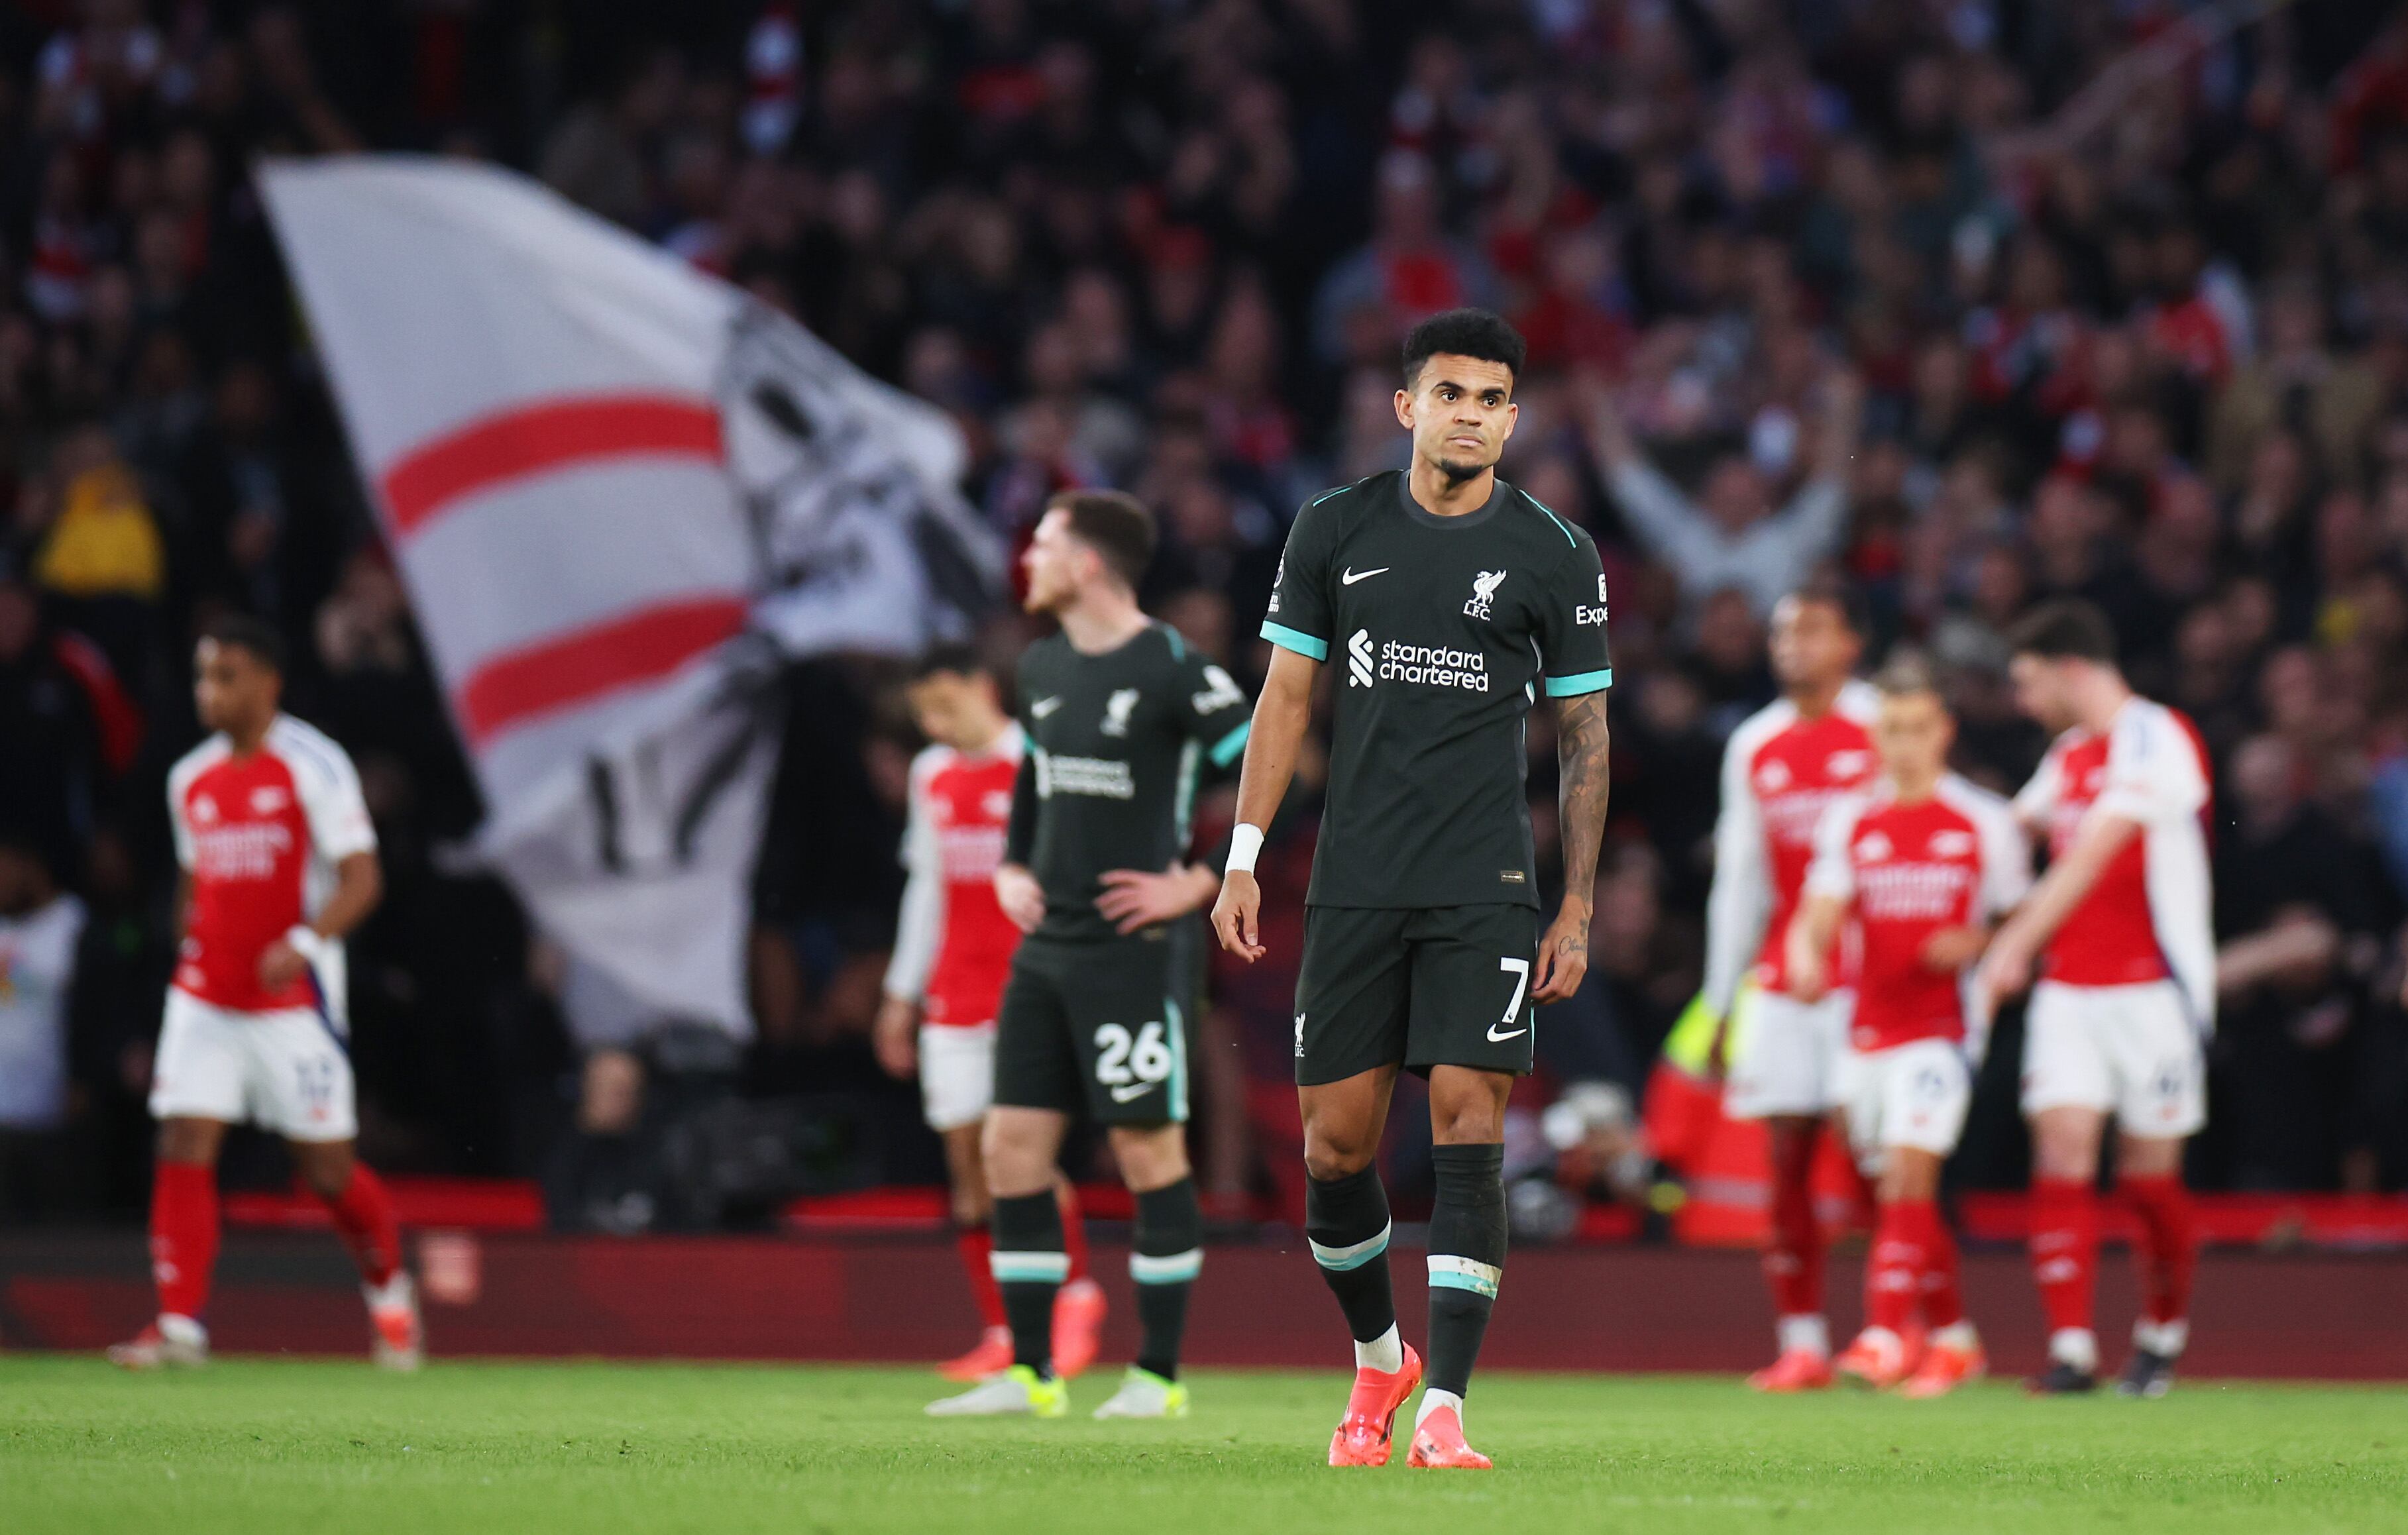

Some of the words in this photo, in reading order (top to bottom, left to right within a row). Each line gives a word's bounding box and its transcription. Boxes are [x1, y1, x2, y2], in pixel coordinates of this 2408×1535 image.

[1379, 660, 1489, 692] chartered
[1382, 639, 1484, 672] standard
[1500, 957, 1529, 1024] 7
[1094, 1021, 1171, 1085] 26
